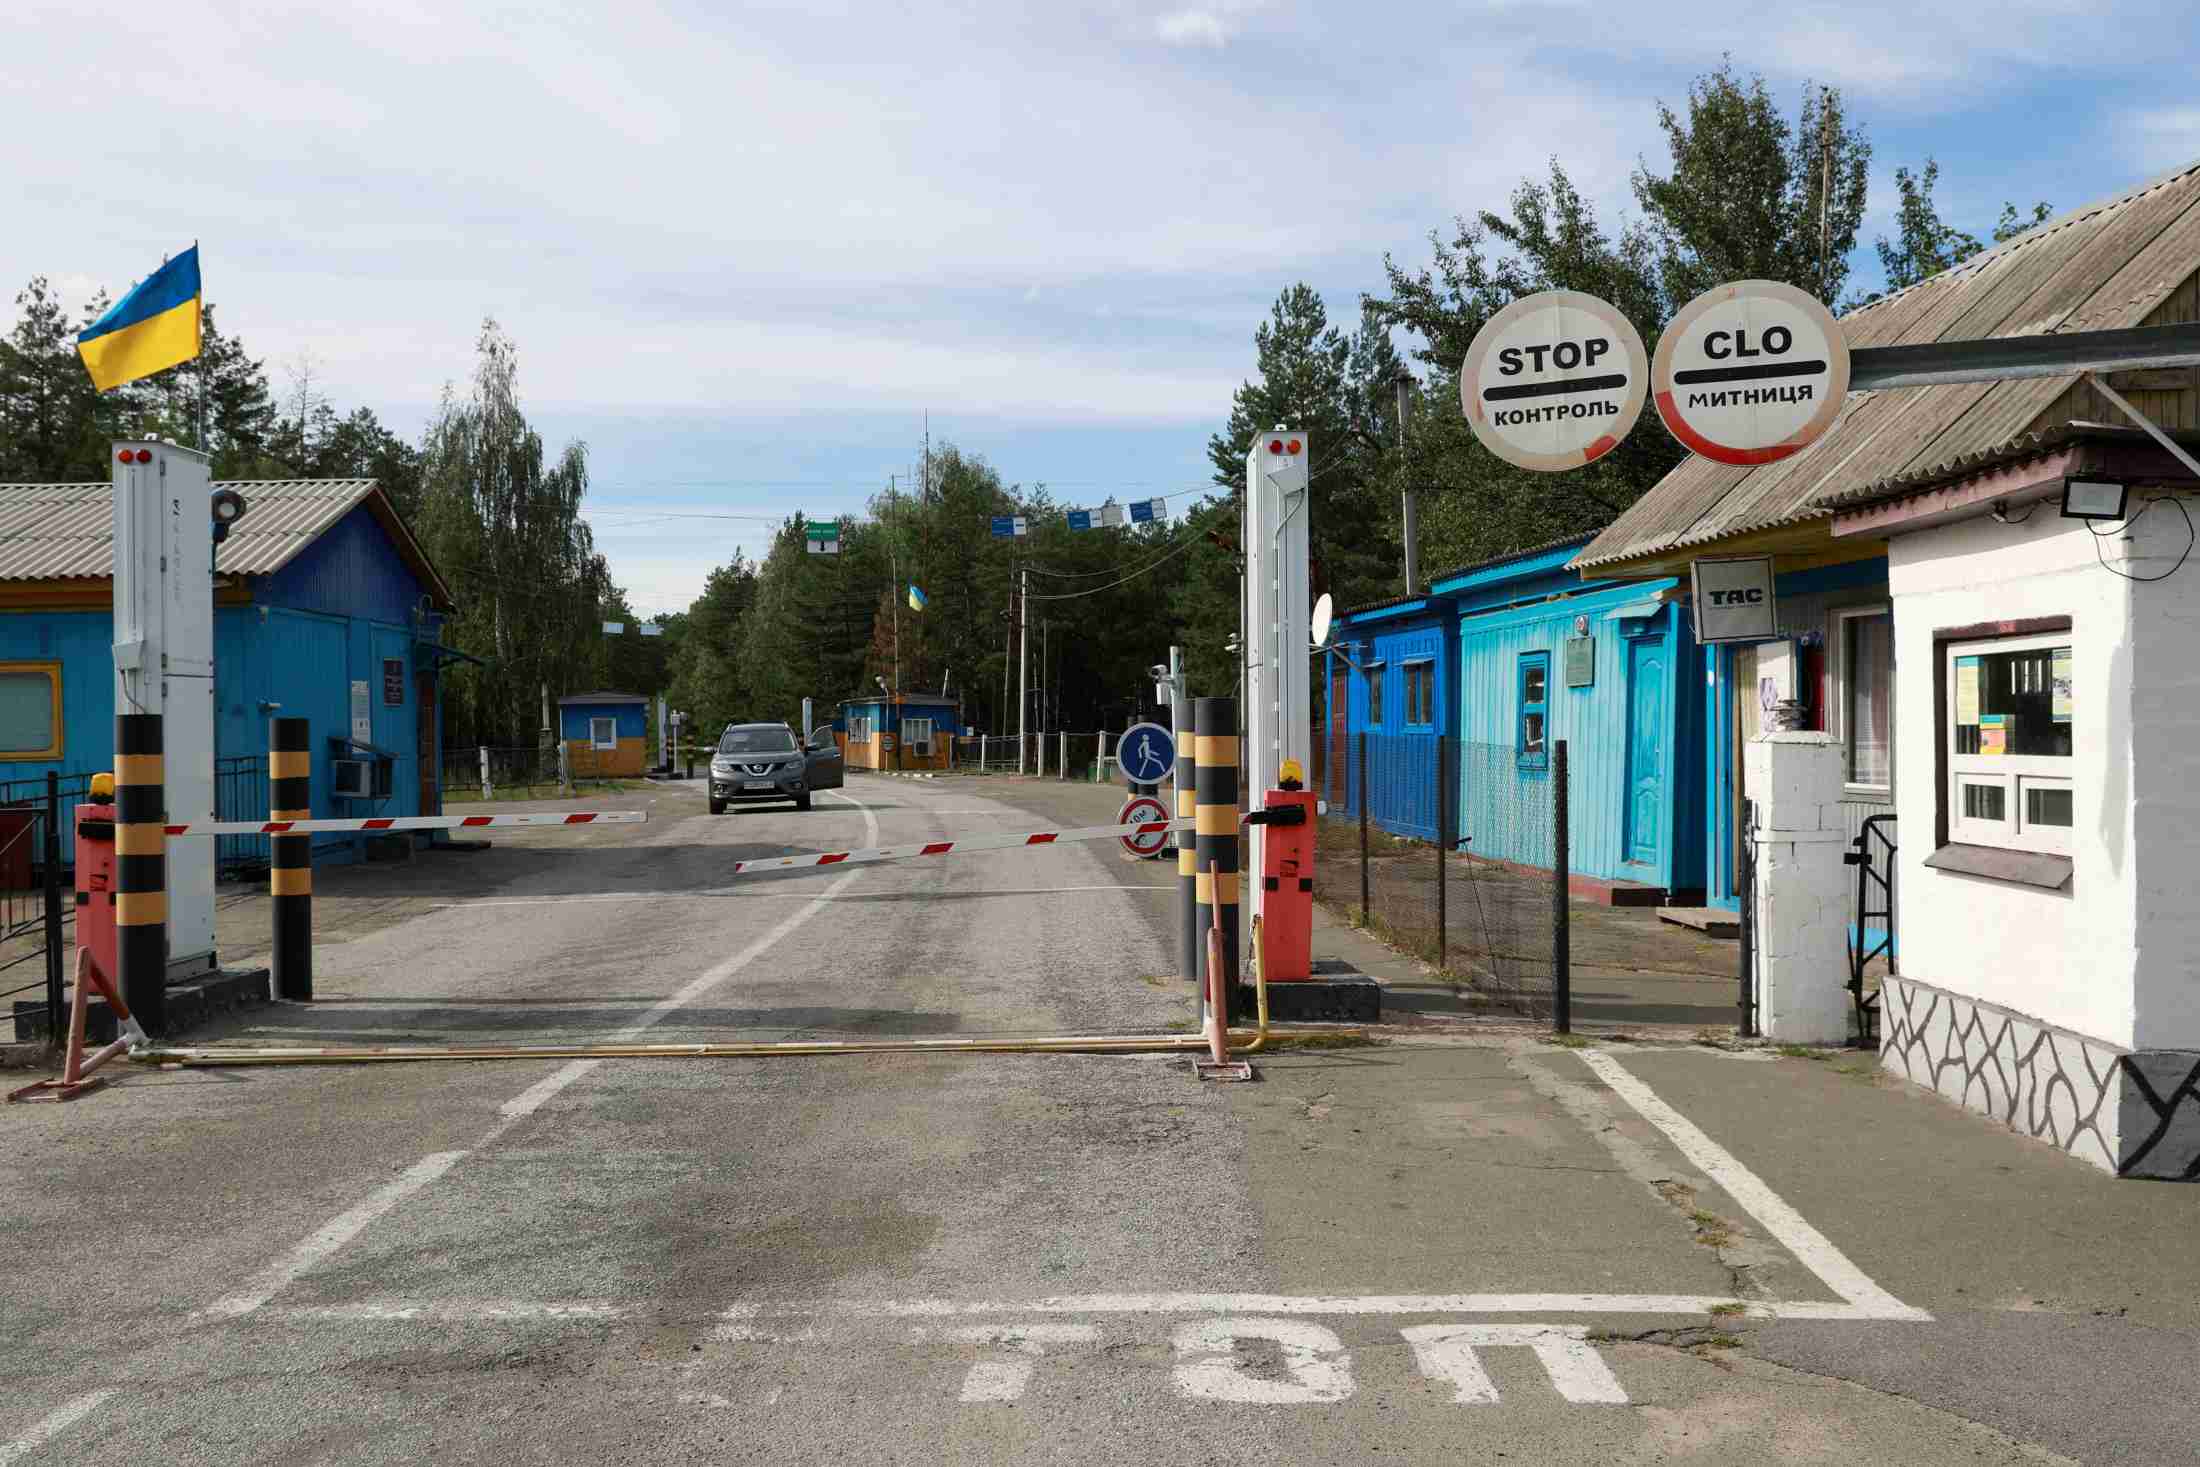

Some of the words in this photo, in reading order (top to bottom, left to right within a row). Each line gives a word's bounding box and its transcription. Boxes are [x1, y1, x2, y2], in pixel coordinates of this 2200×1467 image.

[1498, 338, 1609, 376] STOP
[1703, 326, 1793, 360] CLO
[1494, 400, 1619, 426] КОНТРОЛЬ
[1688, 384, 1813, 408] МИТНИЦЯ
[678, 1320, 1631, 1405] ТОП
